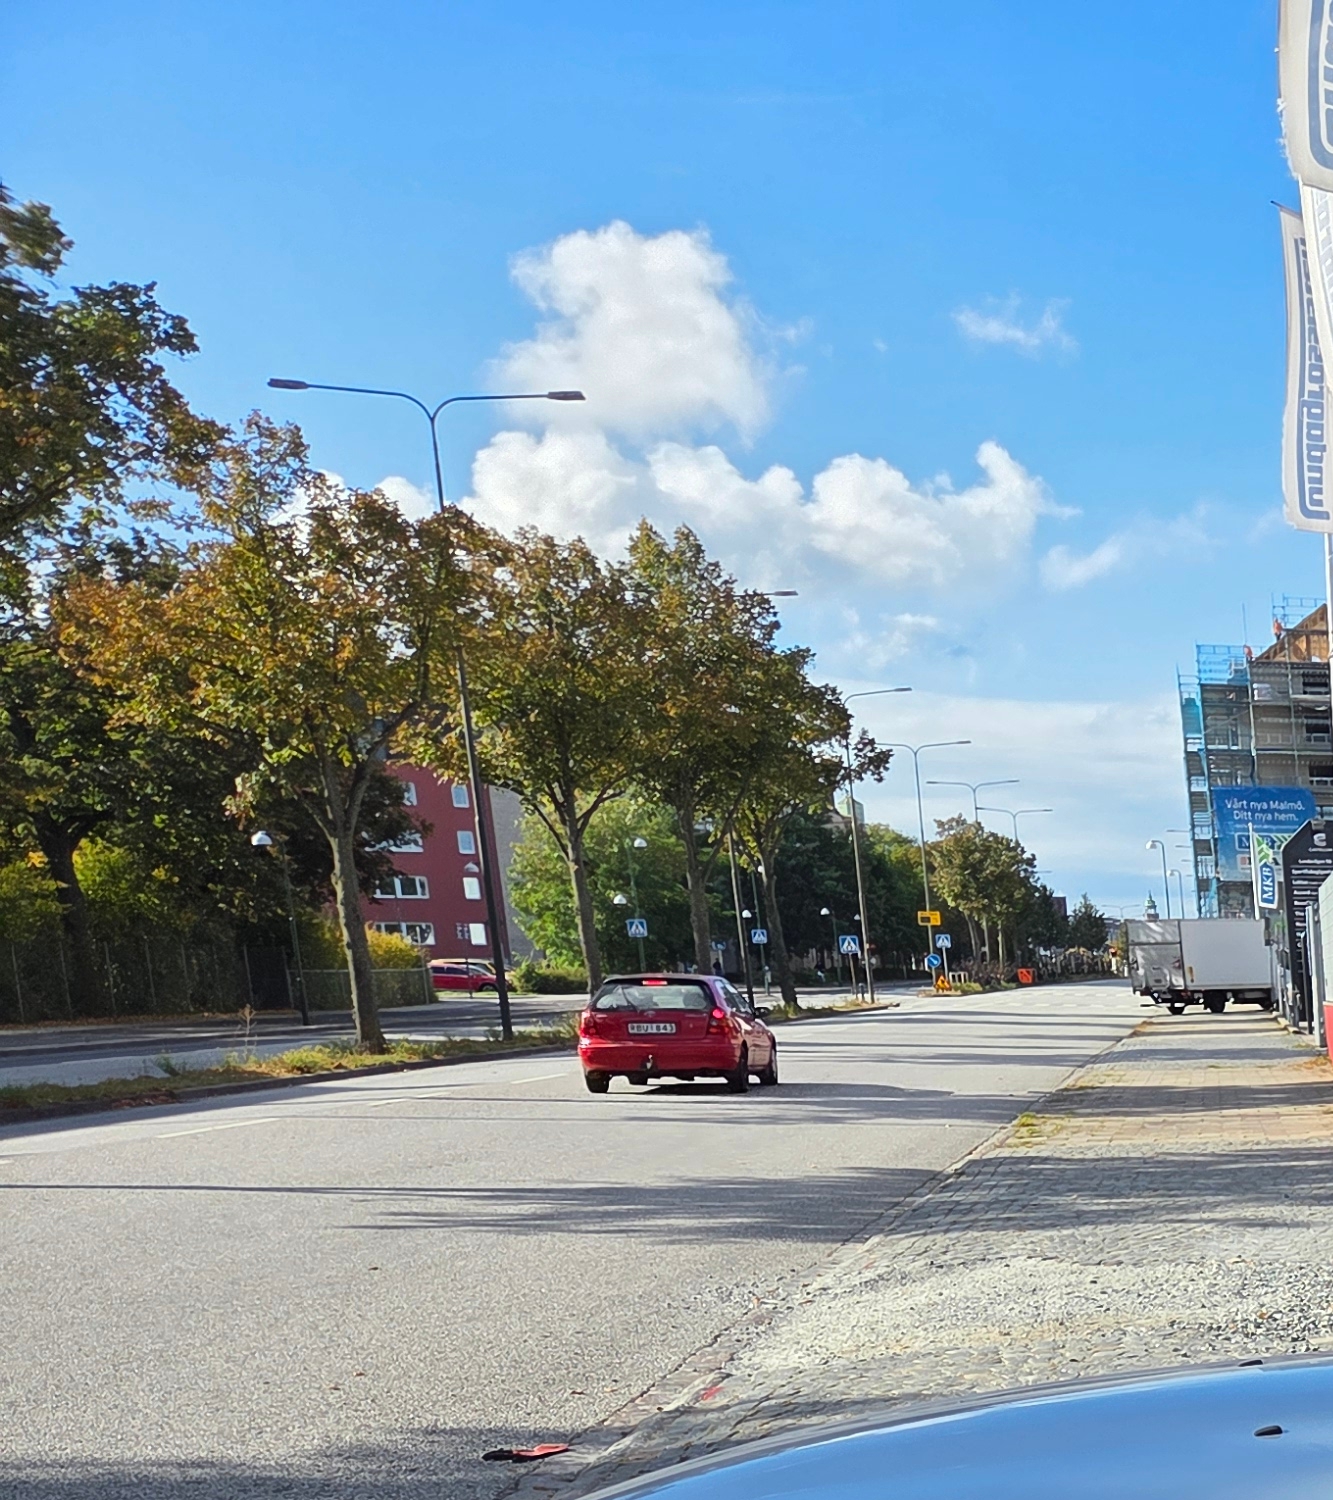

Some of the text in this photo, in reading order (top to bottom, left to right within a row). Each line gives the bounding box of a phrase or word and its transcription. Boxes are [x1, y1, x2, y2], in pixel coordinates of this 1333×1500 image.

[1225, 798, 1306, 811] Vårt nya Malmö.
[1233, 810, 1299, 822] Ditt nya hem.
[1242, 836, 1271, 847] MB
[1262, 867, 1274, 900] MKB
